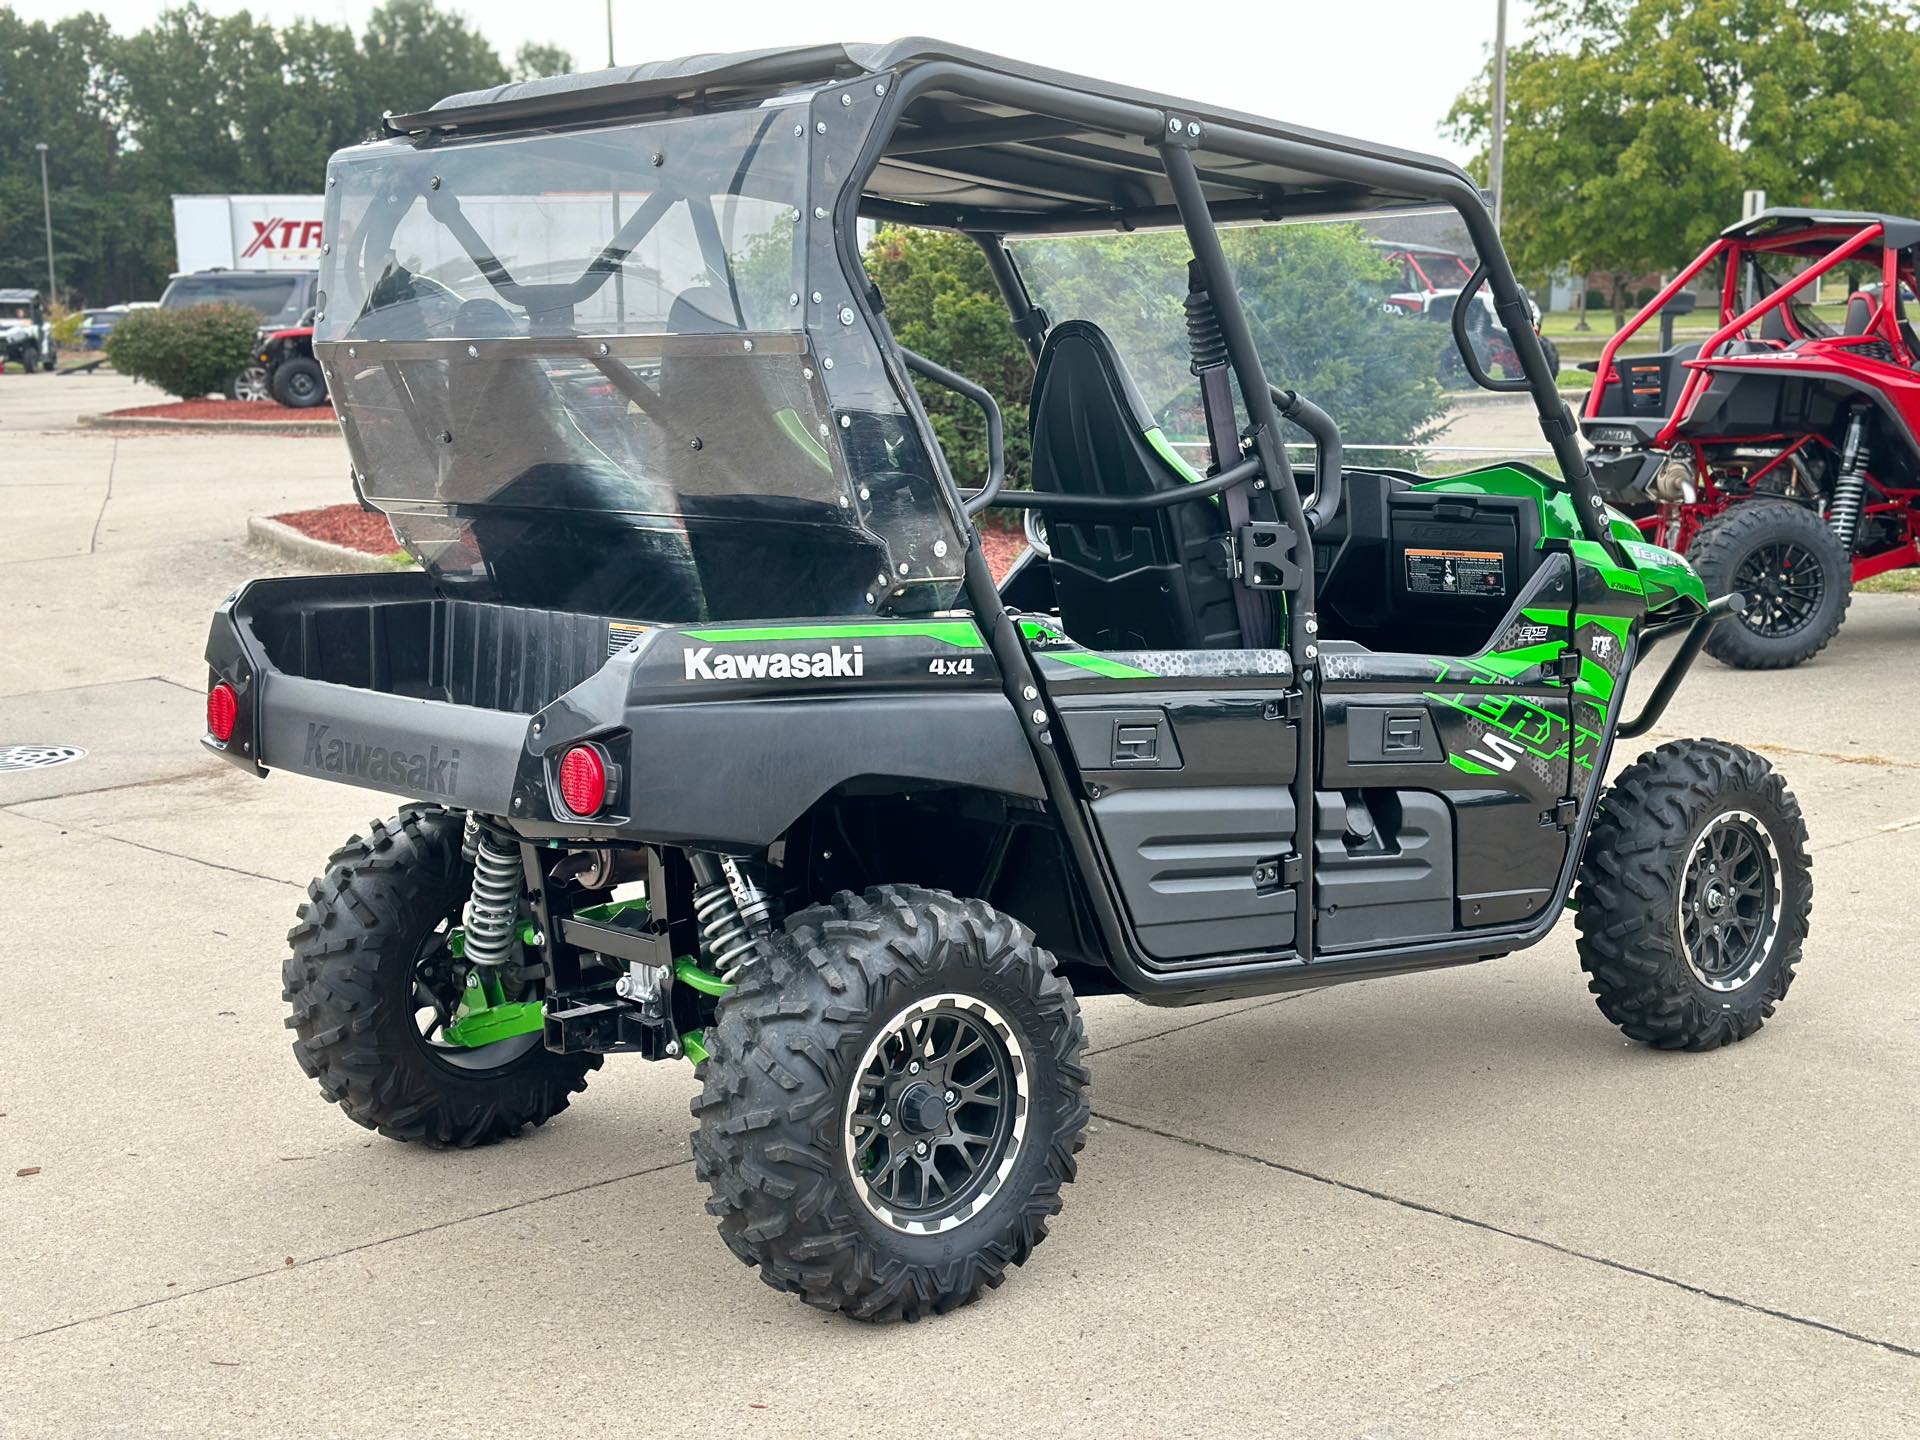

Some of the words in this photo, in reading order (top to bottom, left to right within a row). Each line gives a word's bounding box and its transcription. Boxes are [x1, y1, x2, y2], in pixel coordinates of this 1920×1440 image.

[1519, 626, 1548, 638] EPS
[1591, 636, 1613, 658] FOX
[683, 645, 863, 680] Kawasaki
[928, 658, 974, 676] 4x4
[303, 723, 460, 796] Kawasaki
